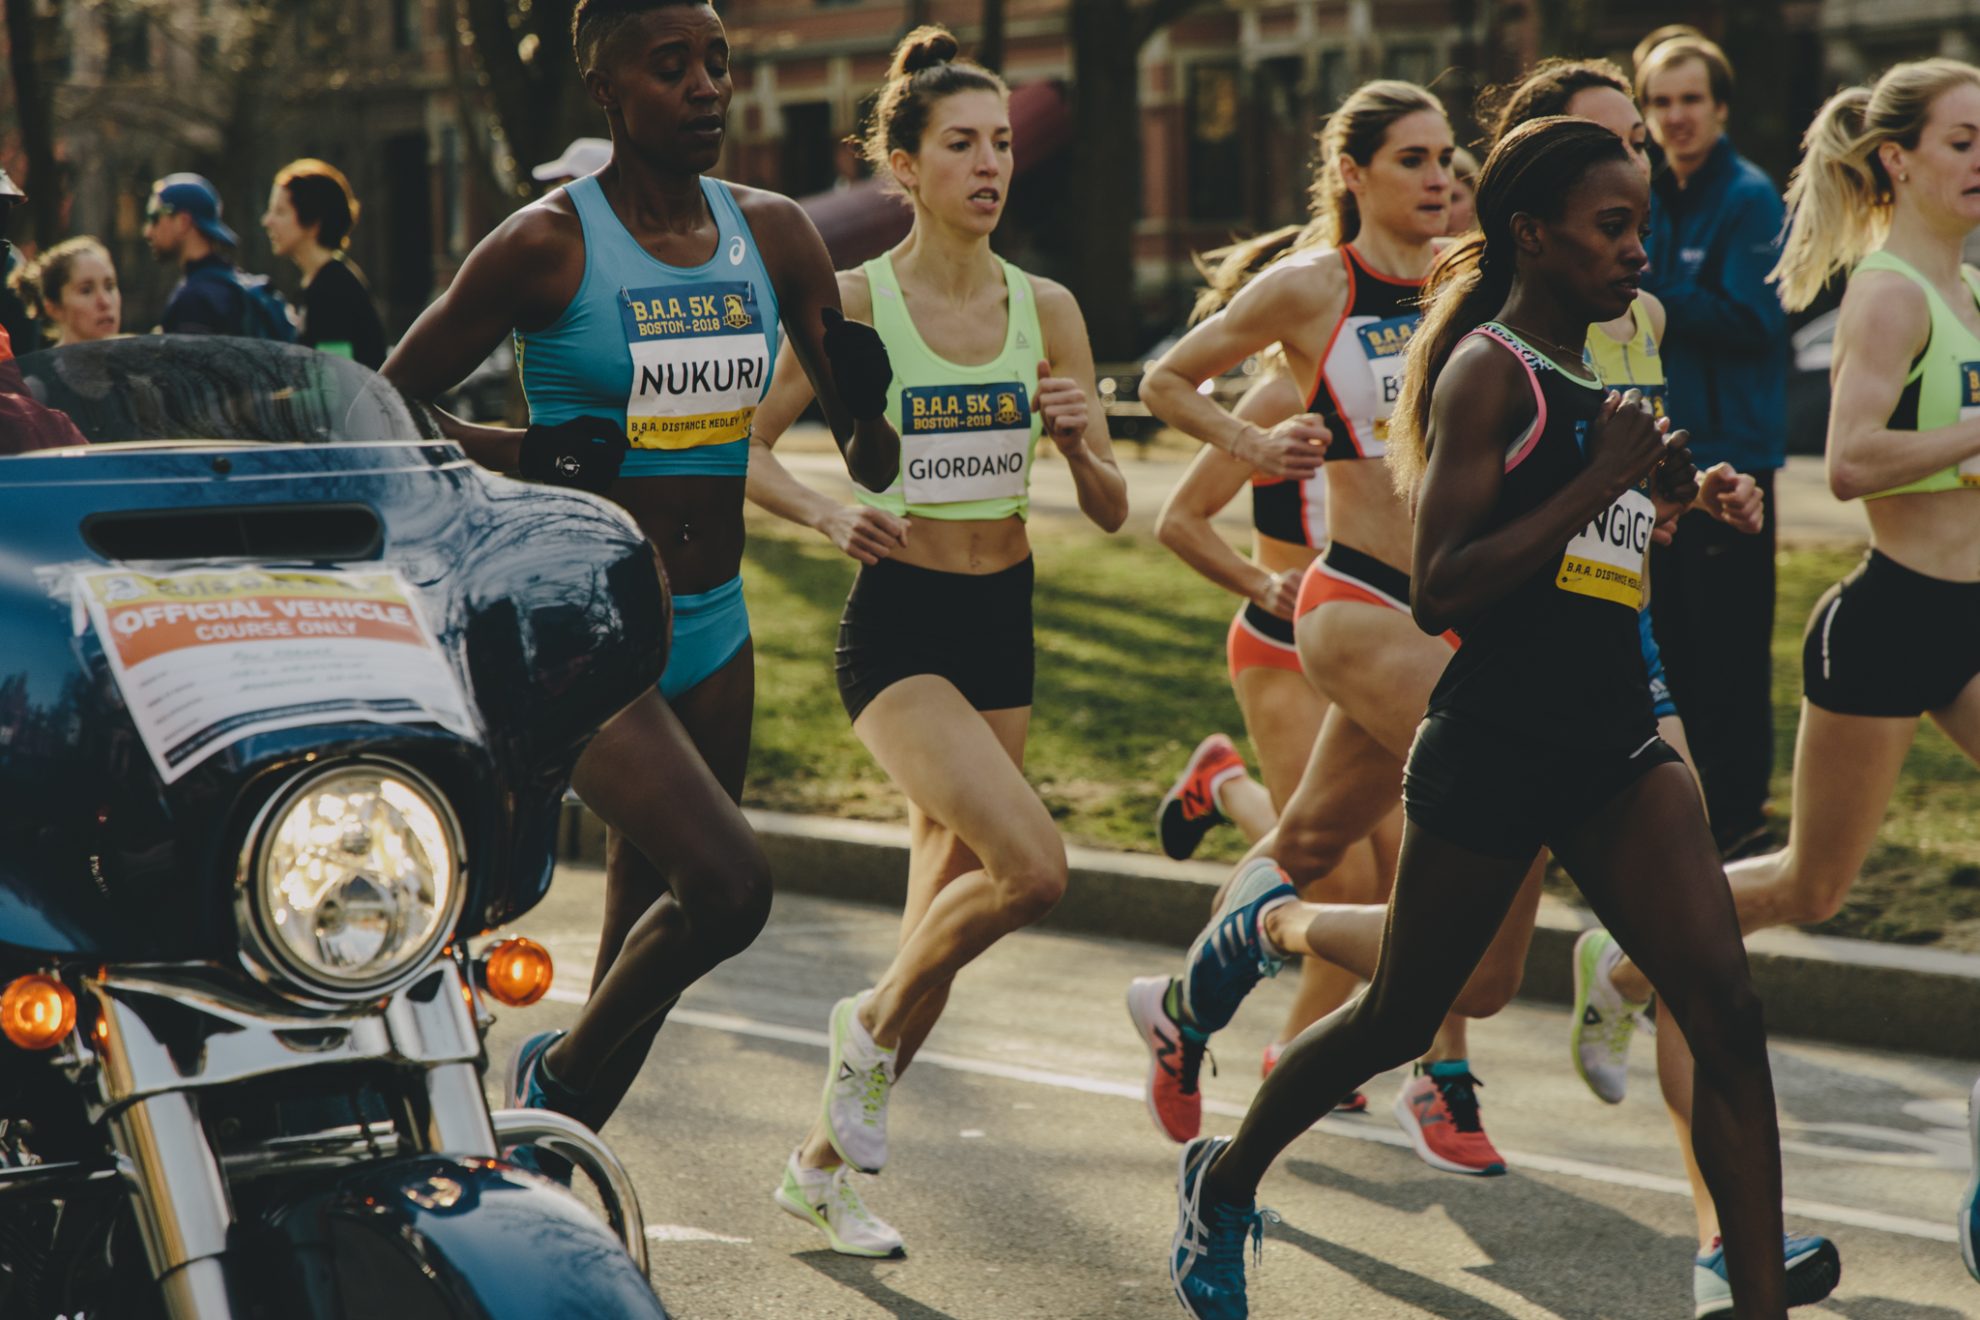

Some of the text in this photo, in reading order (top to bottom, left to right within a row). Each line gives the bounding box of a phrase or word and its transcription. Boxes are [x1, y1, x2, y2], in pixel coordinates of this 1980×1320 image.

[631, 295, 718, 322] B.A.A. 5K
[639, 356, 763, 396] NUKURI
[912, 393, 991, 416] B.A.A. 5K
[661, 419, 707, 432] DISTANCE
[708, 416, 739, 428] MEDLEY
[908, 452, 1023, 480] GIORDANO
[1566, 562, 1592, 577] B.A.A.
[113, 598, 411, 635] OFFICIAL VEHICLE
[195, 620, 357, 641] COURSE ONLY
